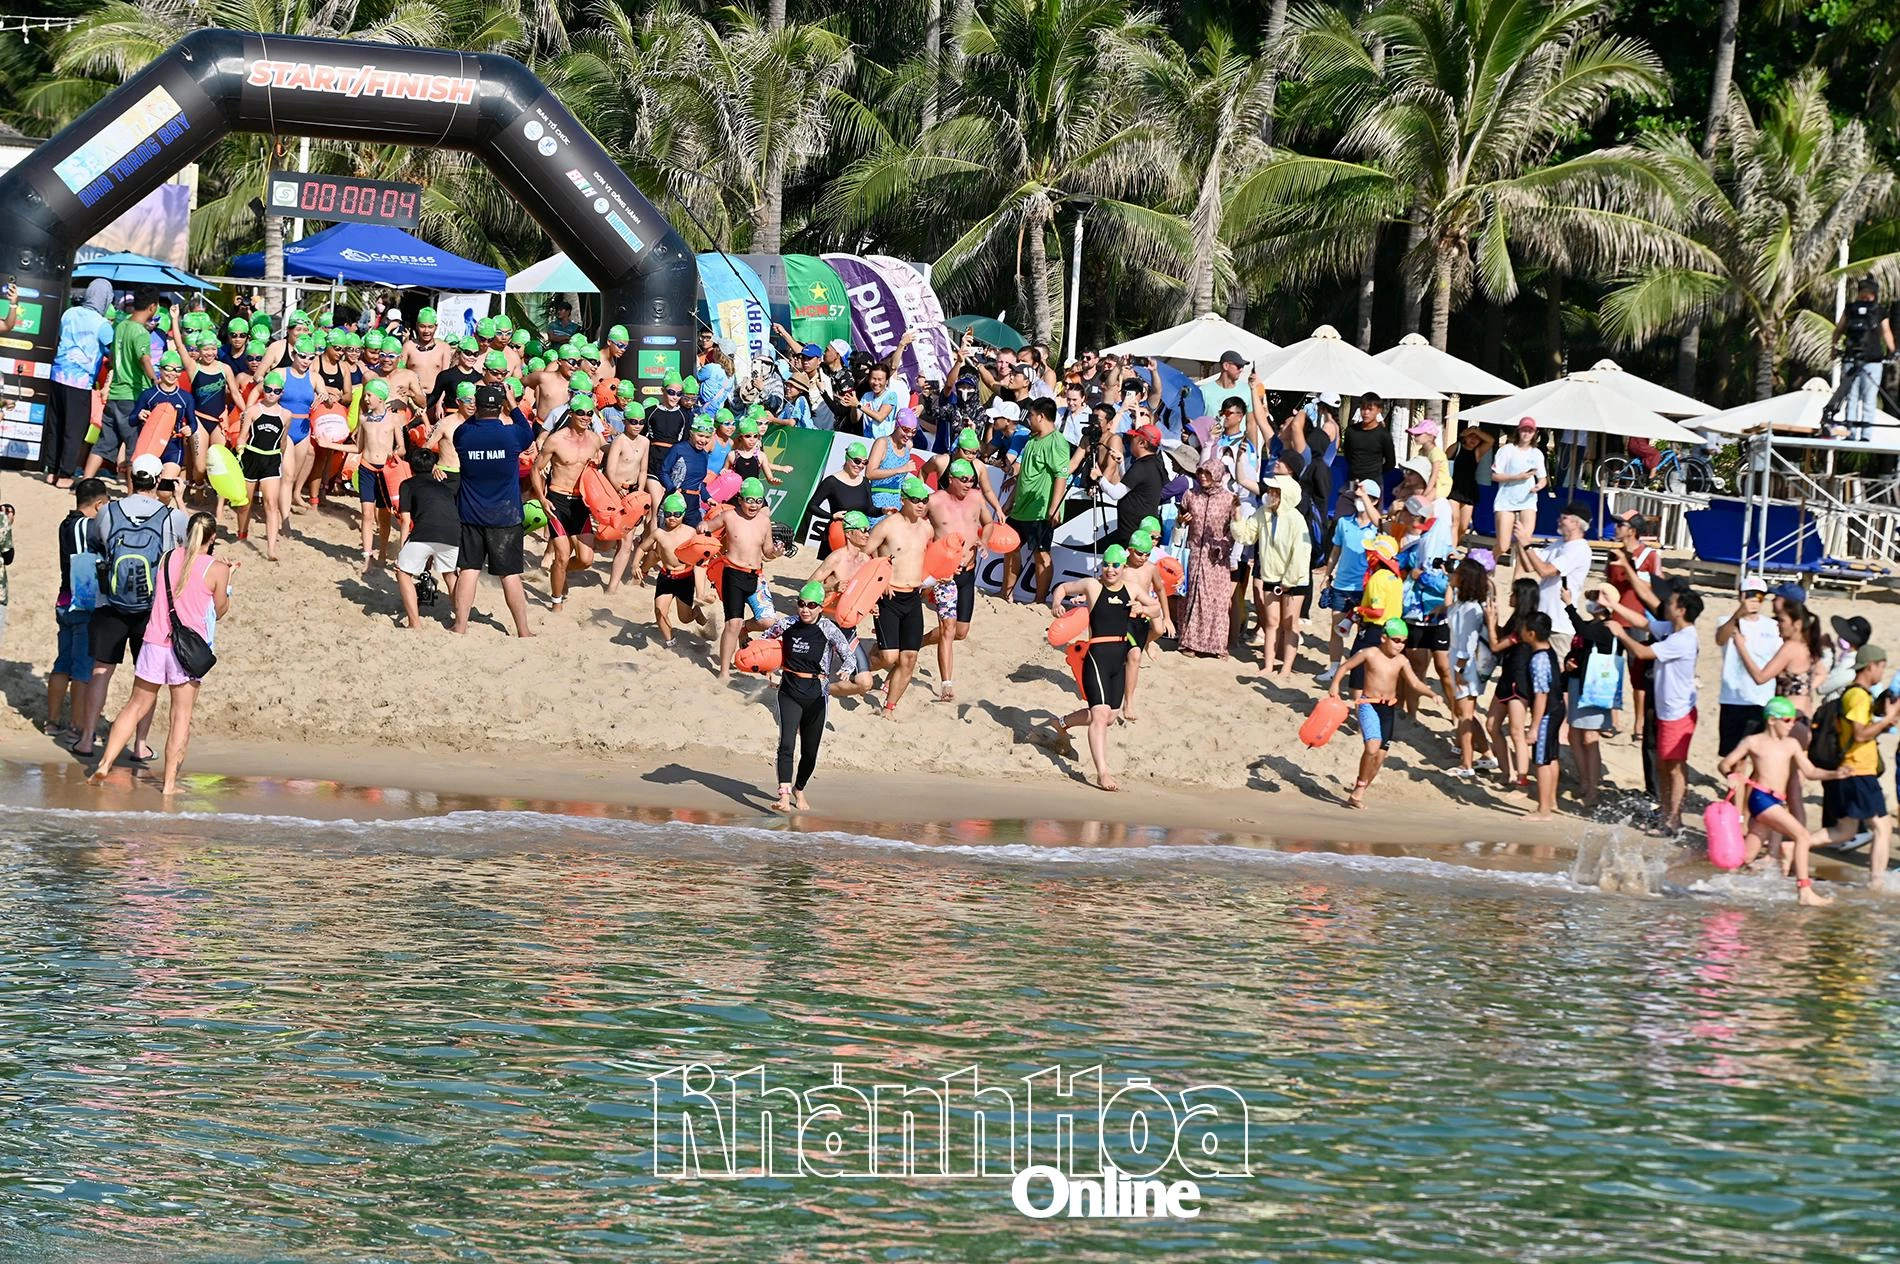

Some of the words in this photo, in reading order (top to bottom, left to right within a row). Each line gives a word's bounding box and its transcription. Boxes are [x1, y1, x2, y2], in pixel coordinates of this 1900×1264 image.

[247, 60, 477, 104] START/FINISH
[157, 111, 191, 146] BAY
[371, 252, 436, 264] CARE365
[795, 303, 846, 318] HCM57
[468, 450, 485, 460] VIET
[486, 449, 506, 460] NAM
